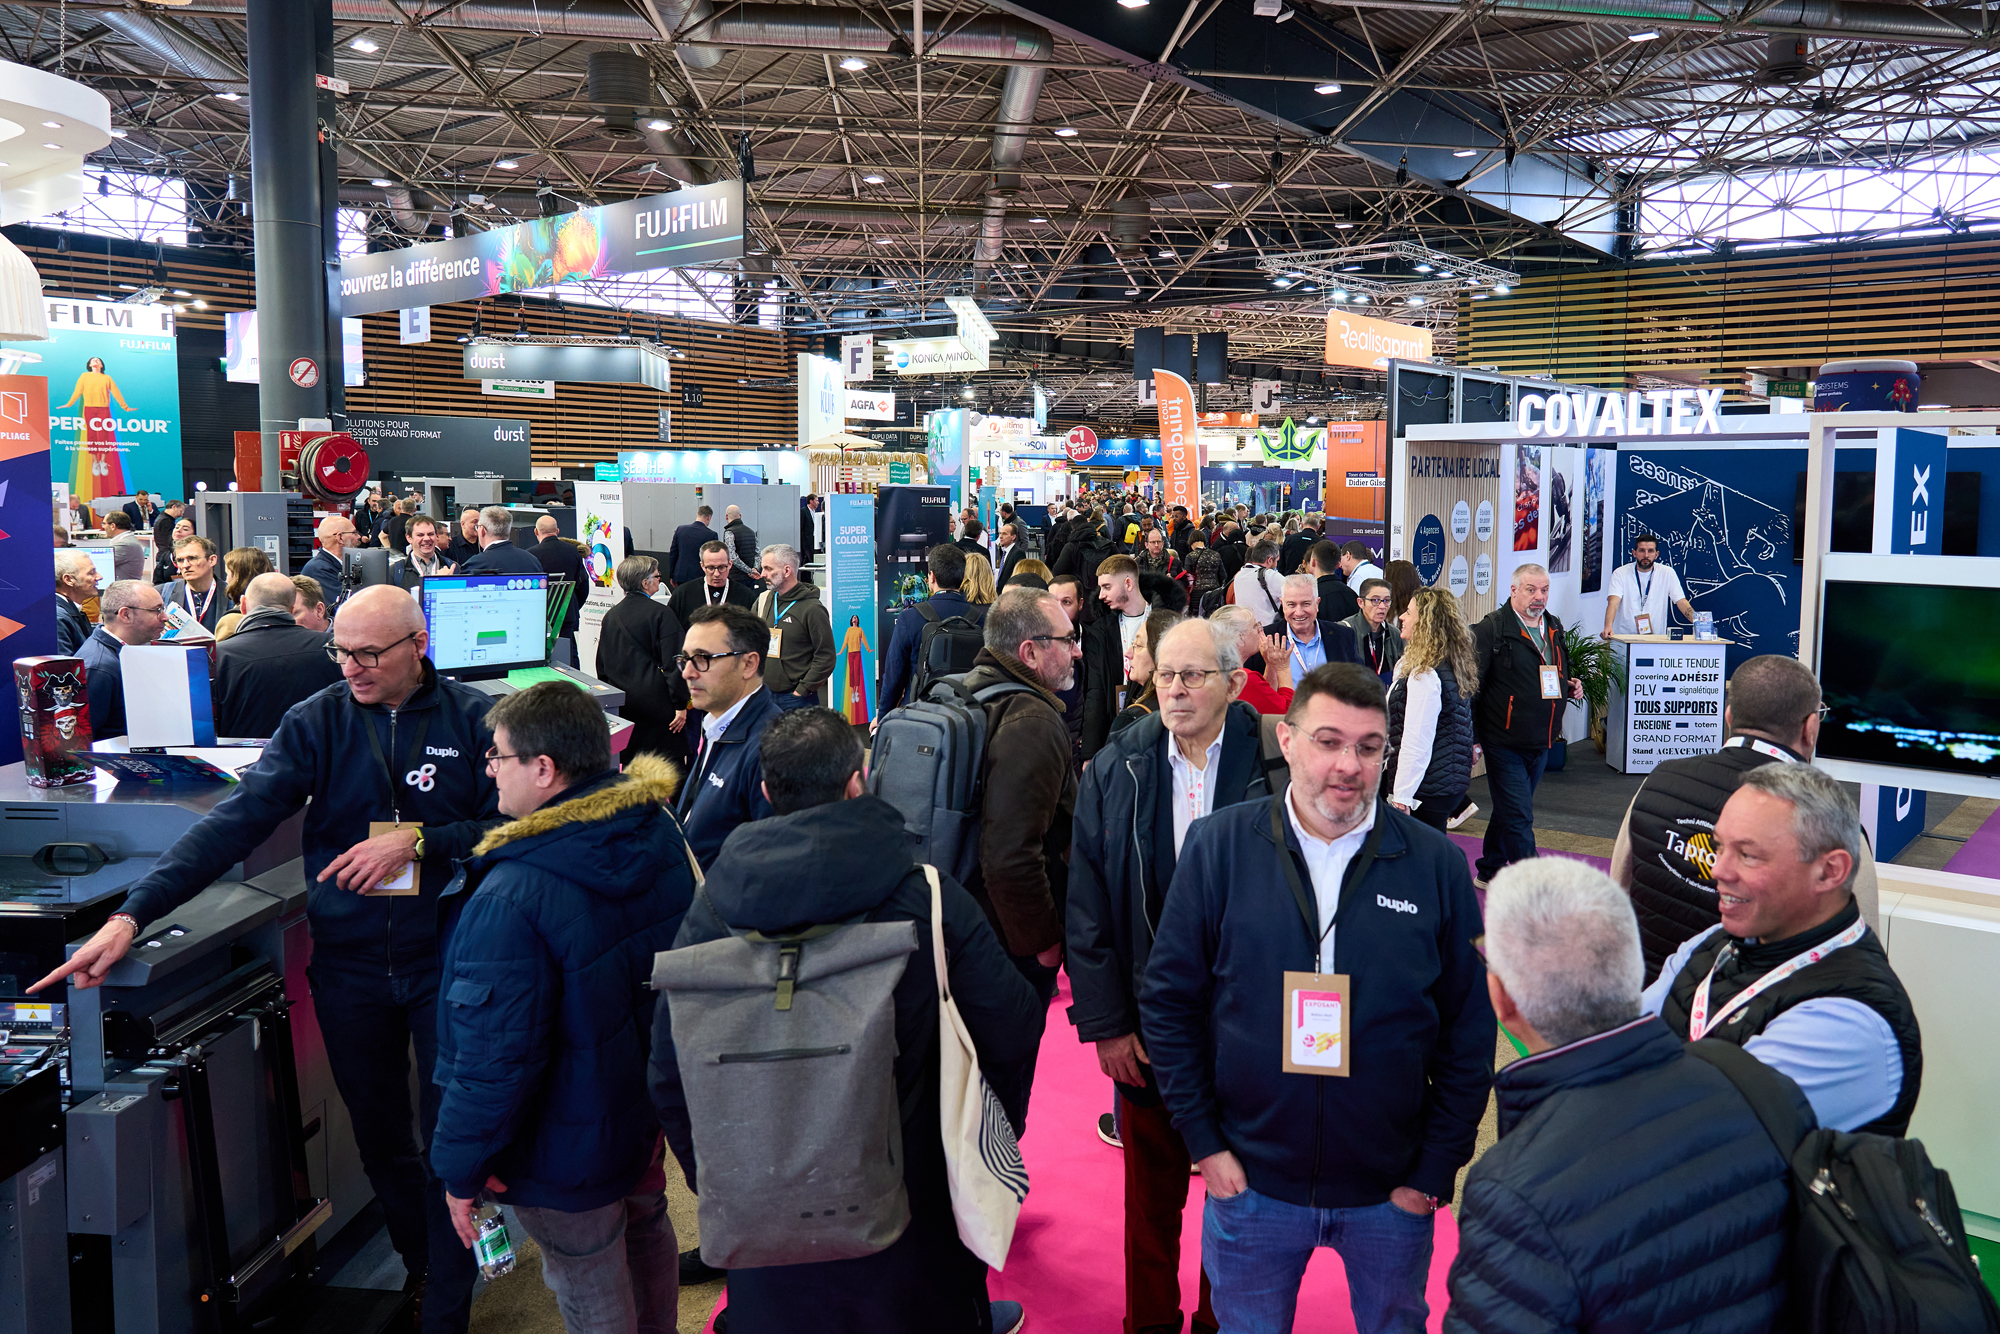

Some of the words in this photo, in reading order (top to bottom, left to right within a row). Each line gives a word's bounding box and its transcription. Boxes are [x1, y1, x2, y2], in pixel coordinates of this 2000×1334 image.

[636, 197, 728, 239] FUJIFILM
[390, 265, 403, 288] la
[405, 256, 480, 286] différence
[120, 339, 171, 351] FUJIFILM
[1340, 320, 1424, 358] Realisaprint
[470, 353, 505, 369] durst
[850, 347, 863, 374] F
[912, 352, 944, 364] KONICA
[945, 351, 976, 363] MINOL
[1774, 382, 1799, 390] Sortie
[684, 393, 702, 403] 1.10
[1260, 390, 1272, 408] J
[851, 400, 875, 410] AGFA
[1518, 388, 1725, 438] COVALTEX
[387, 421, 410, 429] POUR
[0, 432, 31, 441] PLIAGE
[379, 429, 408, 438] GRAND
[410, 430, 442, 439] FORMAT
[493, 425, 525, 442] durst
[1065, 429, 1085, 448] C!
[105, 440, 140, 448] impressions
[1071, 444, 1095, 457] print
[623, 460, 641, 474] SEE
[644, 460, 664, 474] THE
[1410, 455, 1471, 478] PARTENAIRE
[1473, 457, 1500, 478] LOCAL
[839, 525, 866, 535] SUPER
[1423, 526, 1440, 536] Agences
[1659, 658, 1682, 668] TOILE
[1685, 658, 1719, 668] TENDUE
[1635, 673, 1669, 682] covering
[1671, 671, 1719, 682] ADHÉSIF
[1634, 684, 1656, 696] PLV
[1679, 685, 1719, 695] signalétique
[1634, 701, 1661, 713] TOUS
[1664, 701, 1718, 714] SUPPORTS
[1633, 720, 1671, 730] ENSEIGNE
[1632, 734, 1671, 743] GRAND
[1673, 734, 1717, 743] FORMAT
[426, 746, 459, 757] Duplo
[1632, 747, 1653, 755] Stand
[1656, 747, 1717, 755] AGENCEMENT
[1658, 852, 1682, 879] Conception
[1685, 877, 1716, 894] Fabrication
[1376, 894, 1418, 914] Duplo
[1305, 1001, 1339, 1009] EXPOSANT
